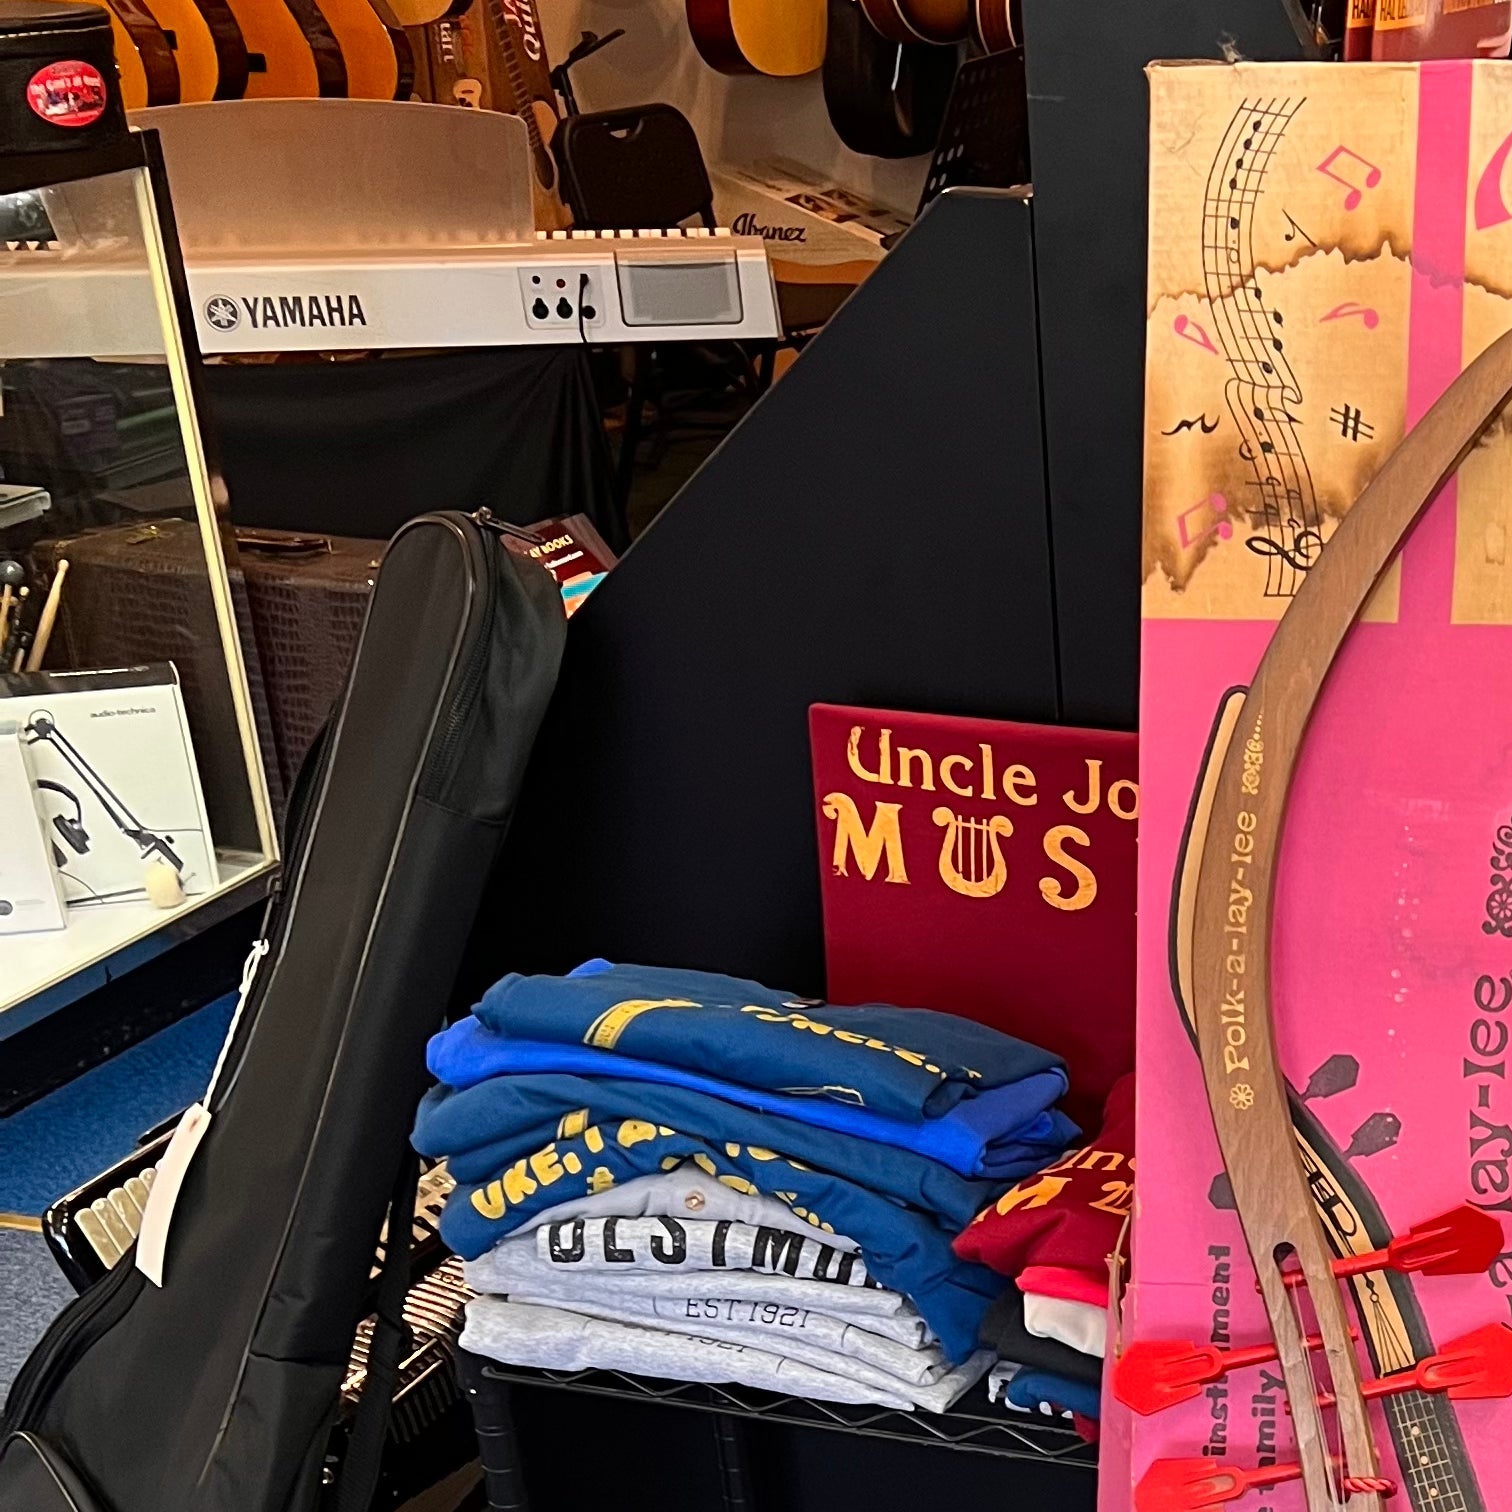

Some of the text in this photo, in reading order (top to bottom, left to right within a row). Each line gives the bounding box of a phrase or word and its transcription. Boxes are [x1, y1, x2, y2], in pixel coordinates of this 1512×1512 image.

[732, 213, 807, 243] Ibanez
[241, 294, 367, 329] YAMAHA
[90, 706, 156, 719] audio-technica
[847, 726, 1140, 820] Uncle Jo
[1220, 810, 1258, 1075] Polk-a-lay-lee
[684, 1297, 812, 1328] EST 1921
[1202, 1244, 1232, 1457] instment
